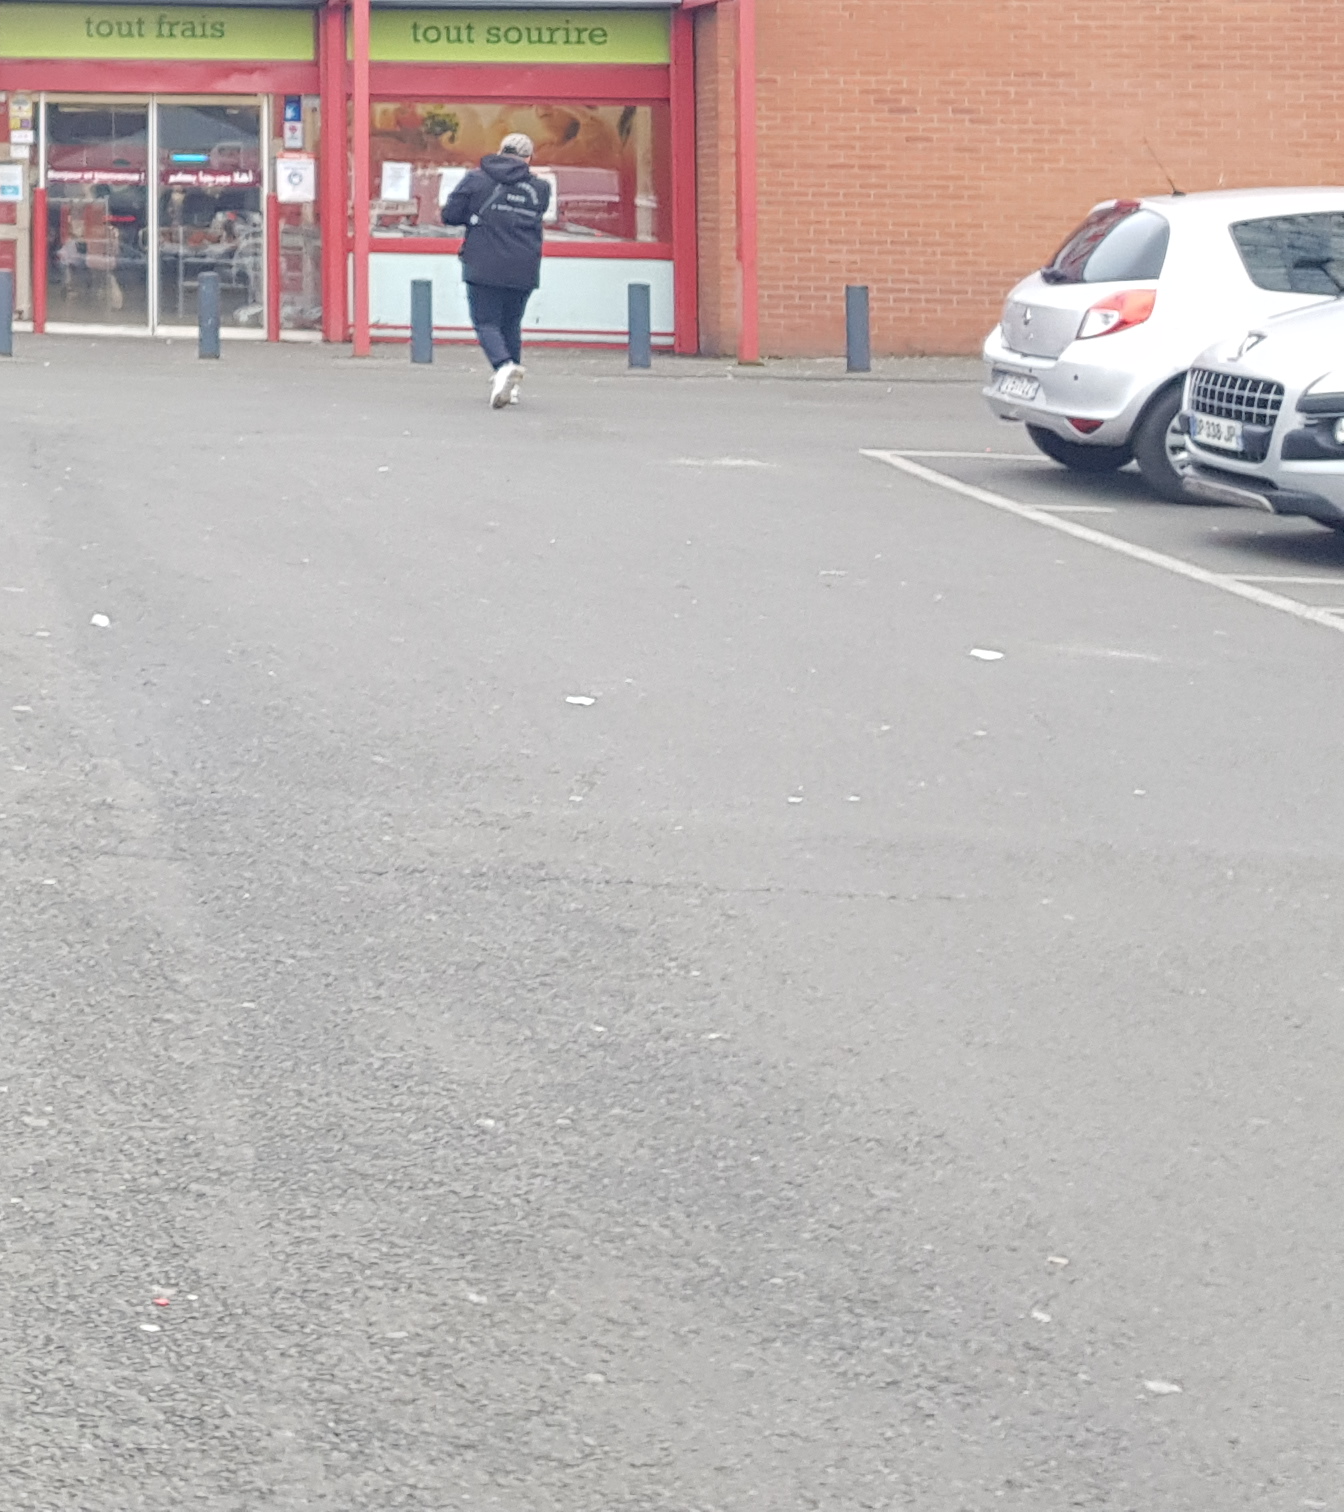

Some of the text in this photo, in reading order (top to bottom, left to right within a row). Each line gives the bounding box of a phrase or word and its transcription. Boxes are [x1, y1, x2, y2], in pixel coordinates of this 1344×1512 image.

[85, 13, 226, 39] tout frais
[411, 19, 609, 45] tout sourire
